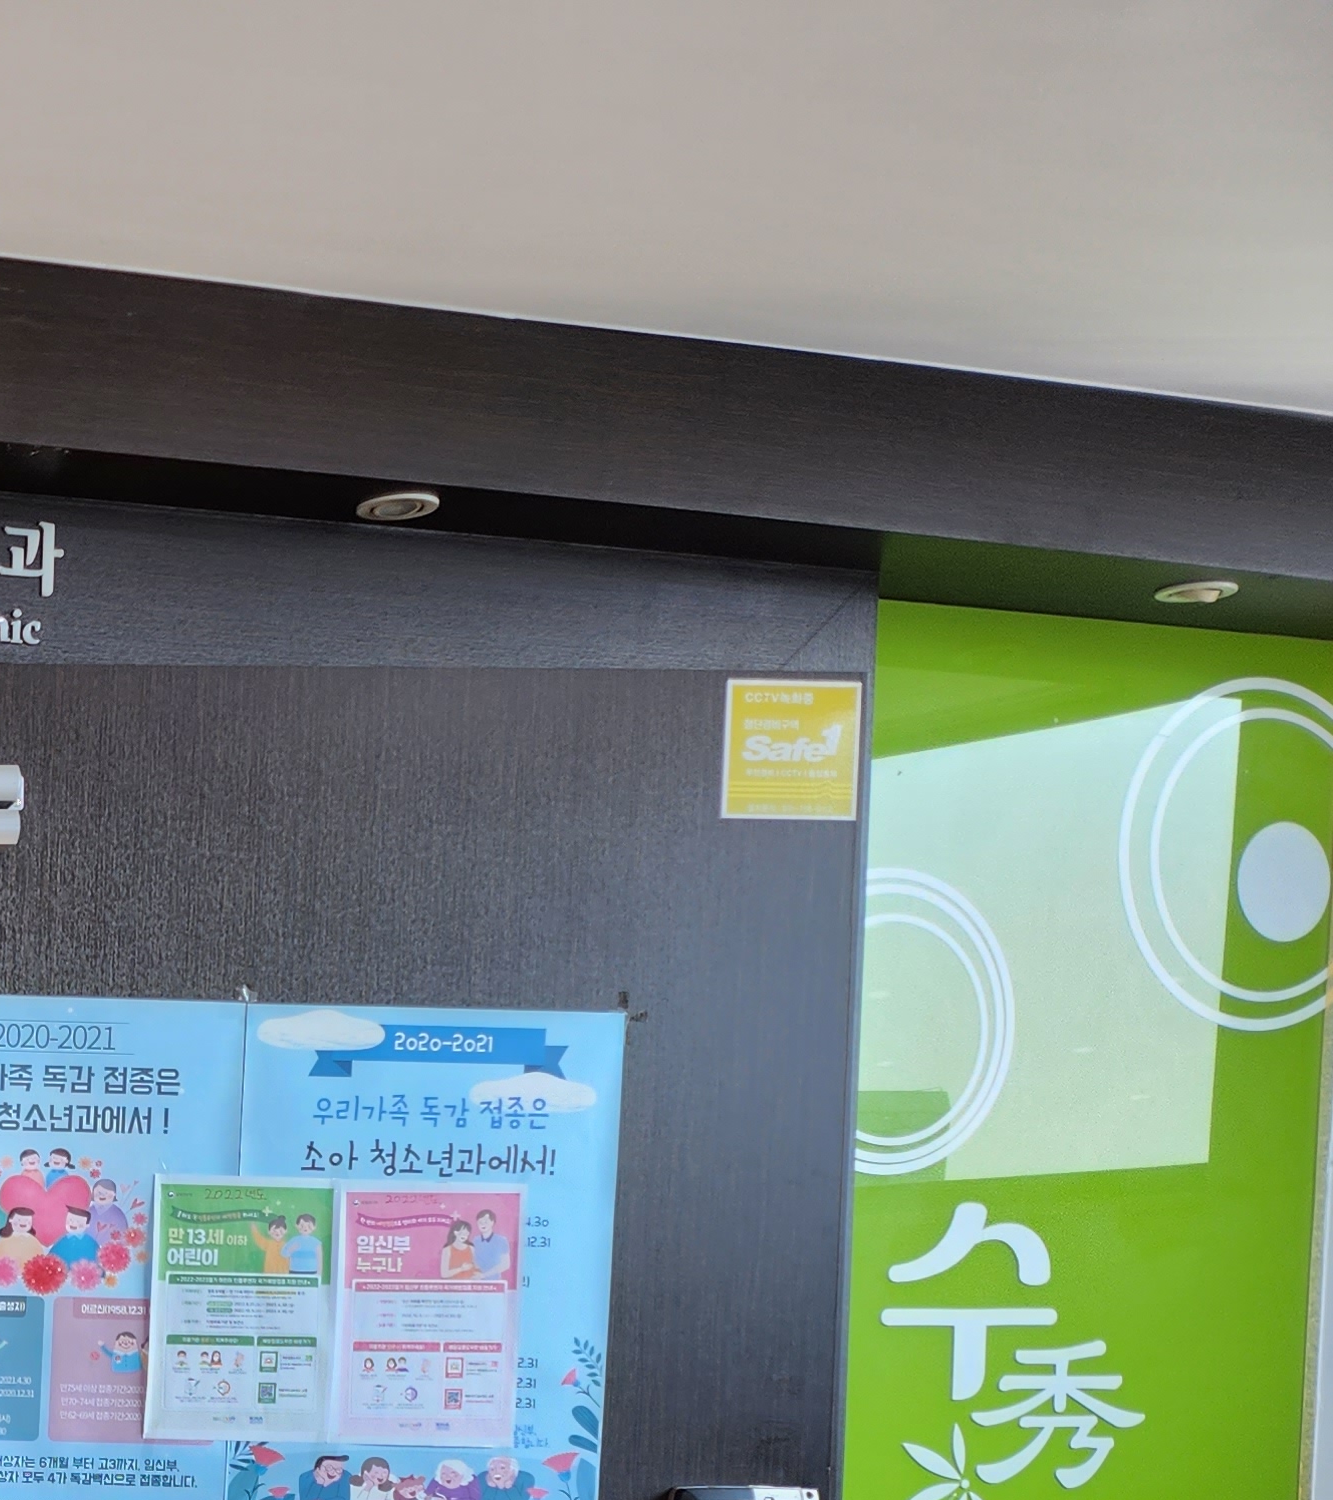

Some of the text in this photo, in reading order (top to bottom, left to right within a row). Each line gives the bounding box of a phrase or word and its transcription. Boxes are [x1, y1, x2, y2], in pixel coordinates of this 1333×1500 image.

[393, 1031, 494, 1054] 2020-2021
[43, 1065, 95, 1094] 독감
[103, 1067, 181, 1096] 접종은
[313, 1094, 550, 1131] 우리가족 독감 접종은
[300, 1139, 358, 1173] 소아
[168, 1228, 248, 1247] 만 13세 이하
[356, 1234, 411, 1255] 임신부
[166, 1248, 219, 1267] 어린이
[356, 1256, 404, 1274] 누구나
[879, 1201, 1059, 1402] 수
[970, 1339, 1146, 1489] 秀
[39, 1456, 69, 1469] 6개월
[73, 1457, 95, 1470] 부터
[22, 1471, 44, 1484] 모두
[47, 1472, 67, 1485] 4가
[70, 1473, 136, 1486] 독감백신으로
